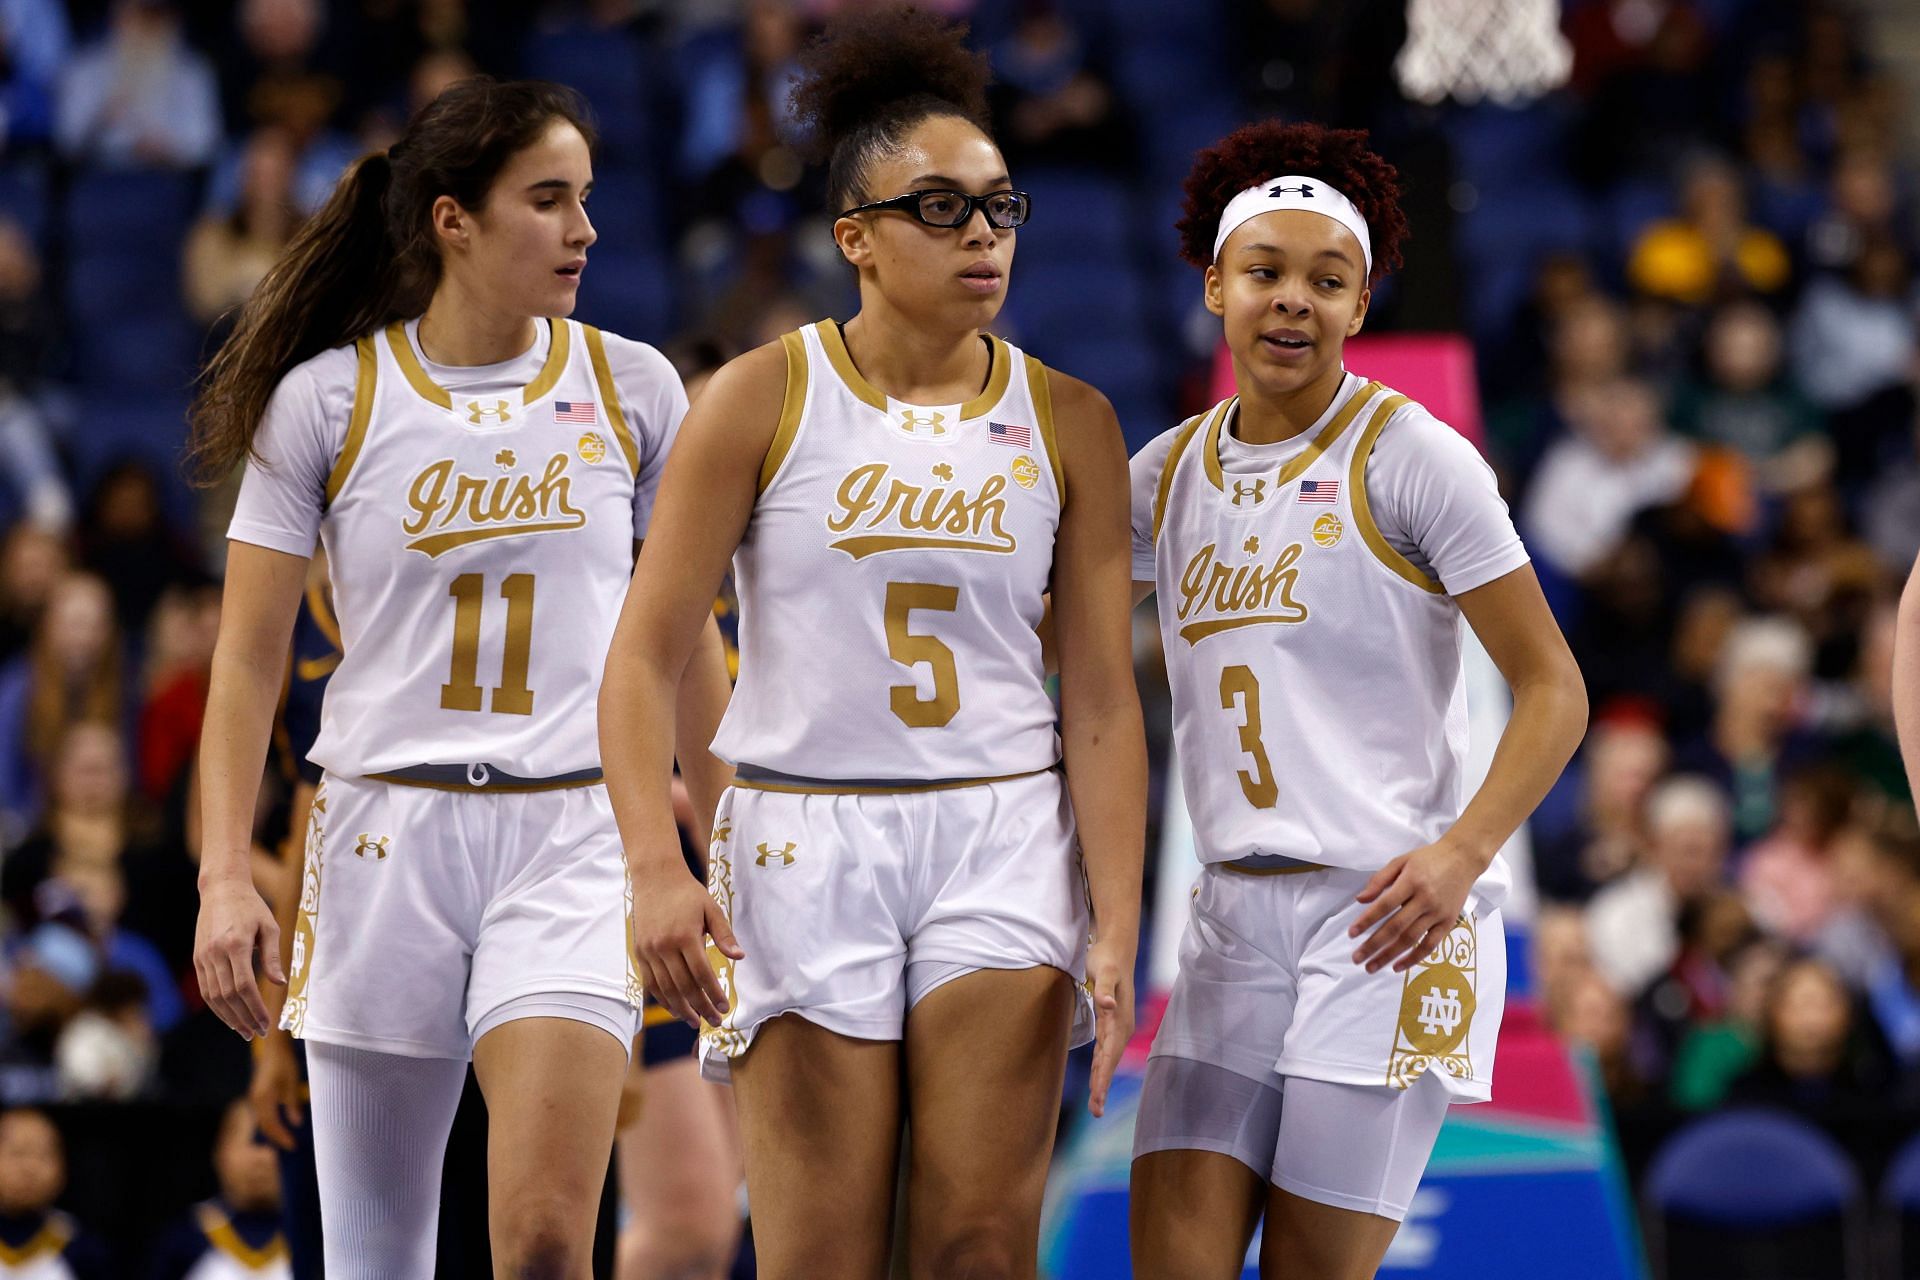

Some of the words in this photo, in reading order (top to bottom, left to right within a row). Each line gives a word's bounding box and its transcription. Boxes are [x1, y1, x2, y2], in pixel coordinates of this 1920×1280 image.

[402, 450, 586, 559] Irish
[826, 461, 1017, 561] Irish
[1015, 464, 1040, 477] ACC
[1316, 522, 1343, 533] ACC
[440, 573, 535, 716] 11
[1176, 541, 1308, 648] Irish
[884, 581, 960, 728] 5
[1219, 665, 1279, 809] 3
